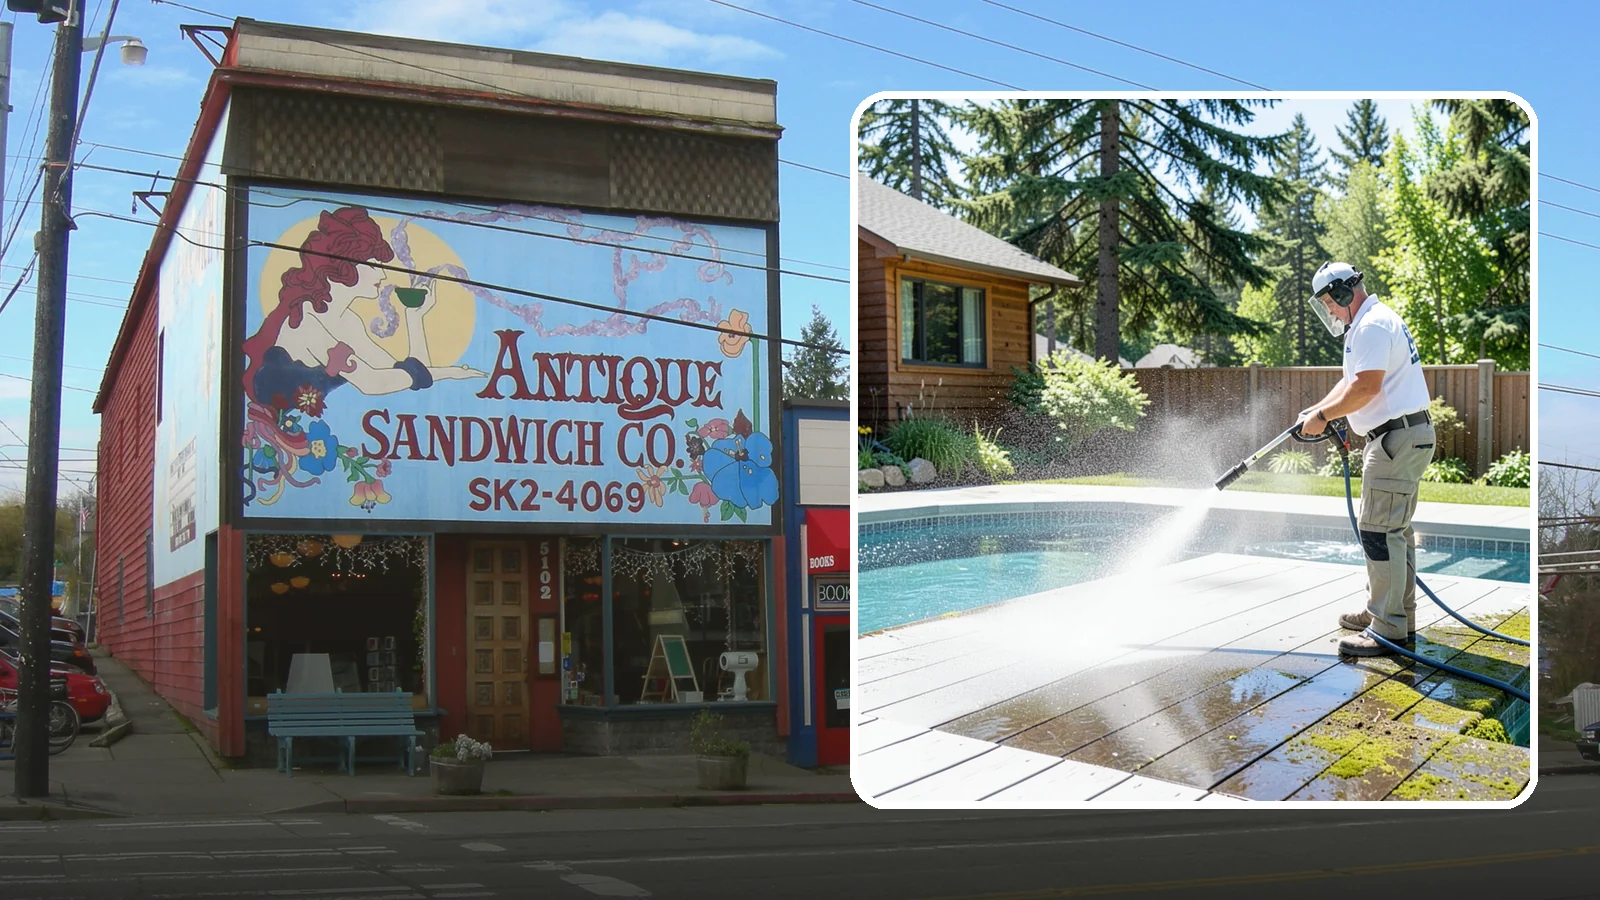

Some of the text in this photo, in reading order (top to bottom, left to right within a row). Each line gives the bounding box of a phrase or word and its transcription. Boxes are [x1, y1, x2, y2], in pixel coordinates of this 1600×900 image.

[475, 329, 724, 421] ANTIQUE
[361, 408, 686, 469] SANDWICH CO.
[467, 477, 645, 513] SK2-4069
[540, 541, 551, 600] 5102
[809, 555, 835, 569] BOOKS
